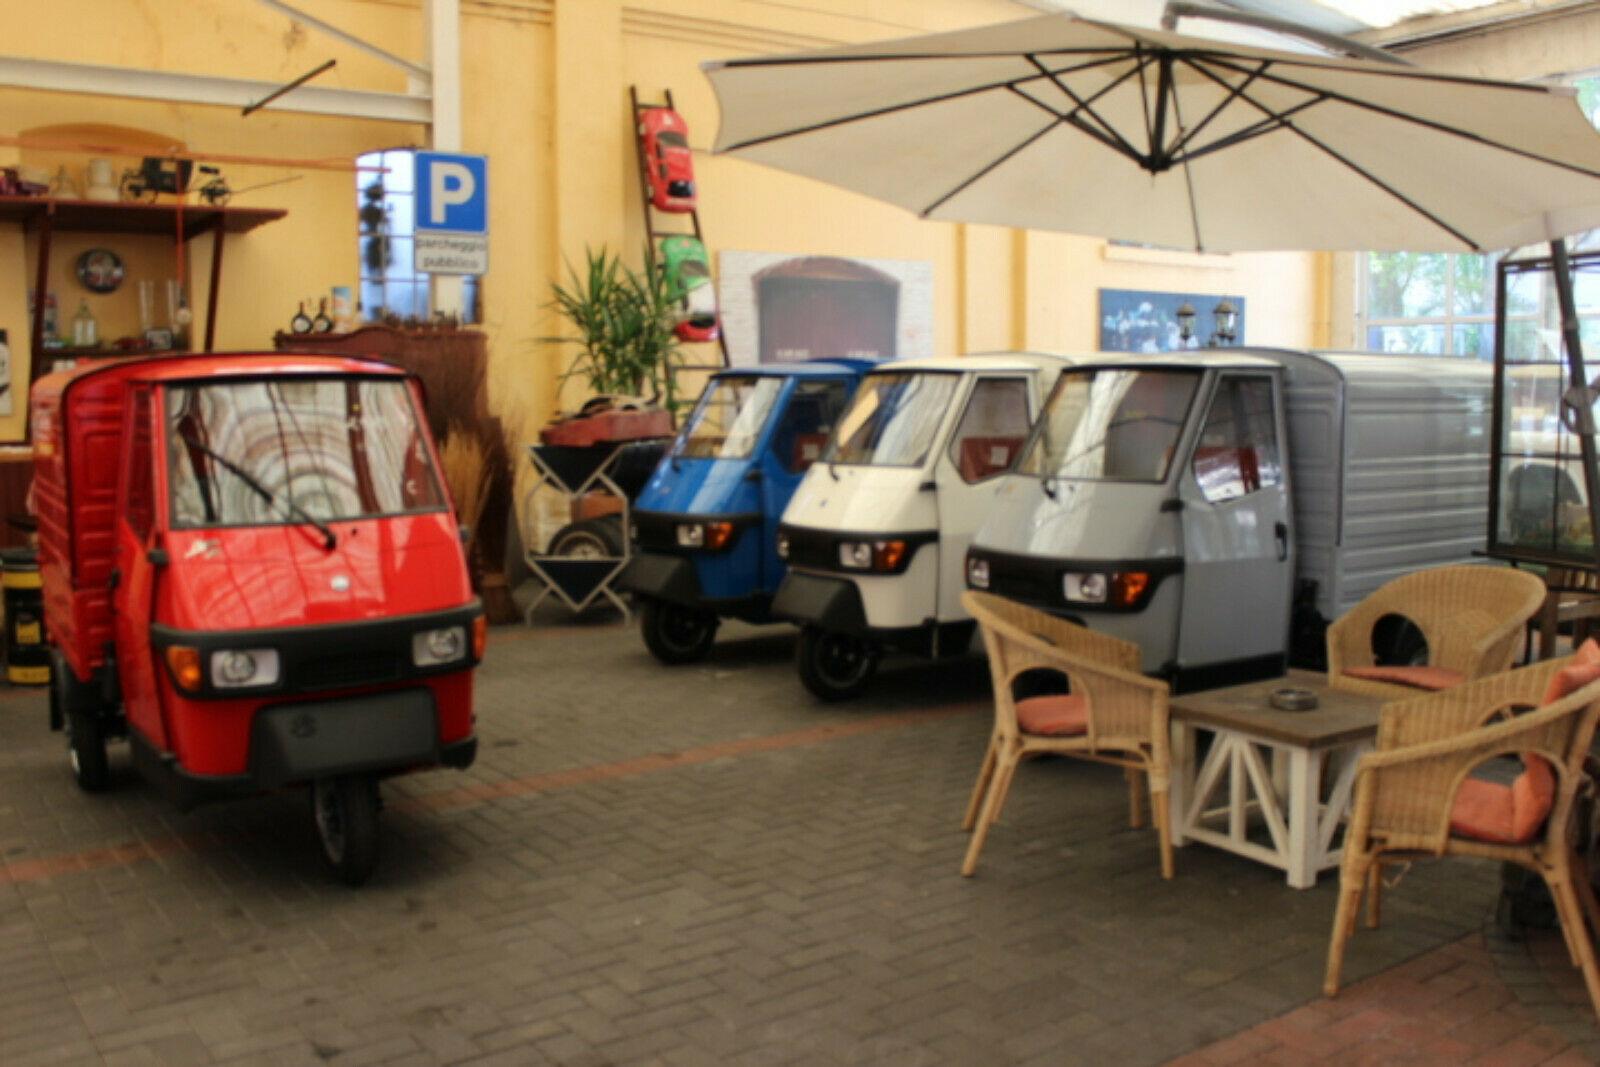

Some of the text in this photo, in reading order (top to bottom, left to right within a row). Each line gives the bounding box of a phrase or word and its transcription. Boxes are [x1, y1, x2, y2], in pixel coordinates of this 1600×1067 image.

[430, 161, 475, 224] P
[416, 238, 486, 252] parcheggio
[423, 256, 479, 269] pubblico
